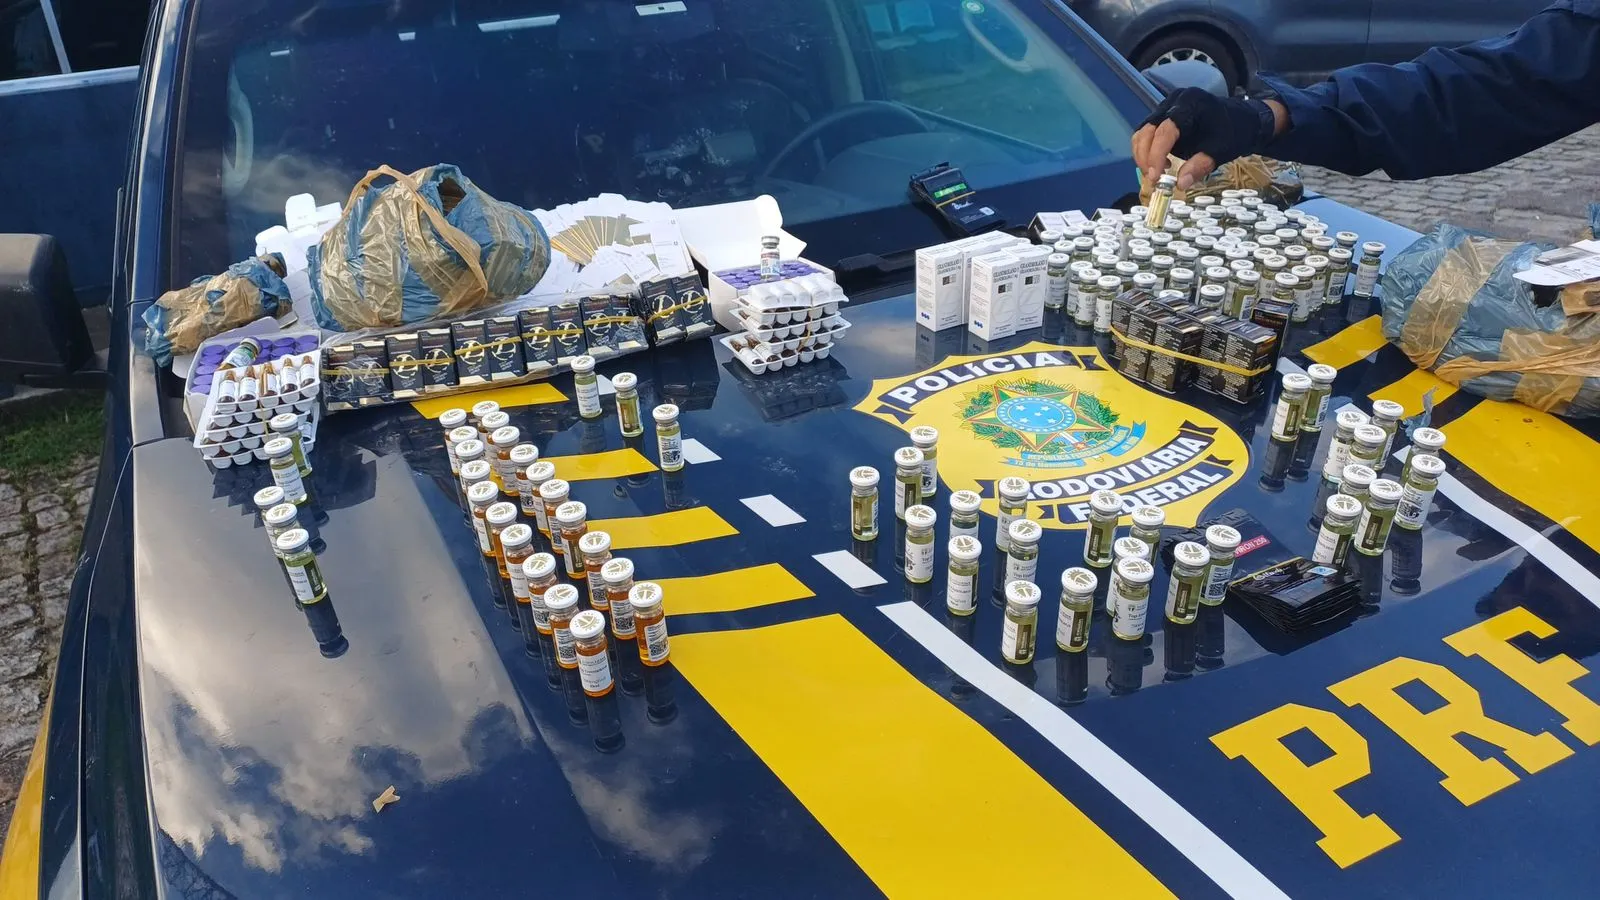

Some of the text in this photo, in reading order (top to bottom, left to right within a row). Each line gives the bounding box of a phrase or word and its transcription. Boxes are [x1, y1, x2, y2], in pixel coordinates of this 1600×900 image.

[888, 352, 1065, 405] POLÍCIA
[1068, 470, 1224, 522] FDERAL
[1208, 606, 1600, 869] PRF
